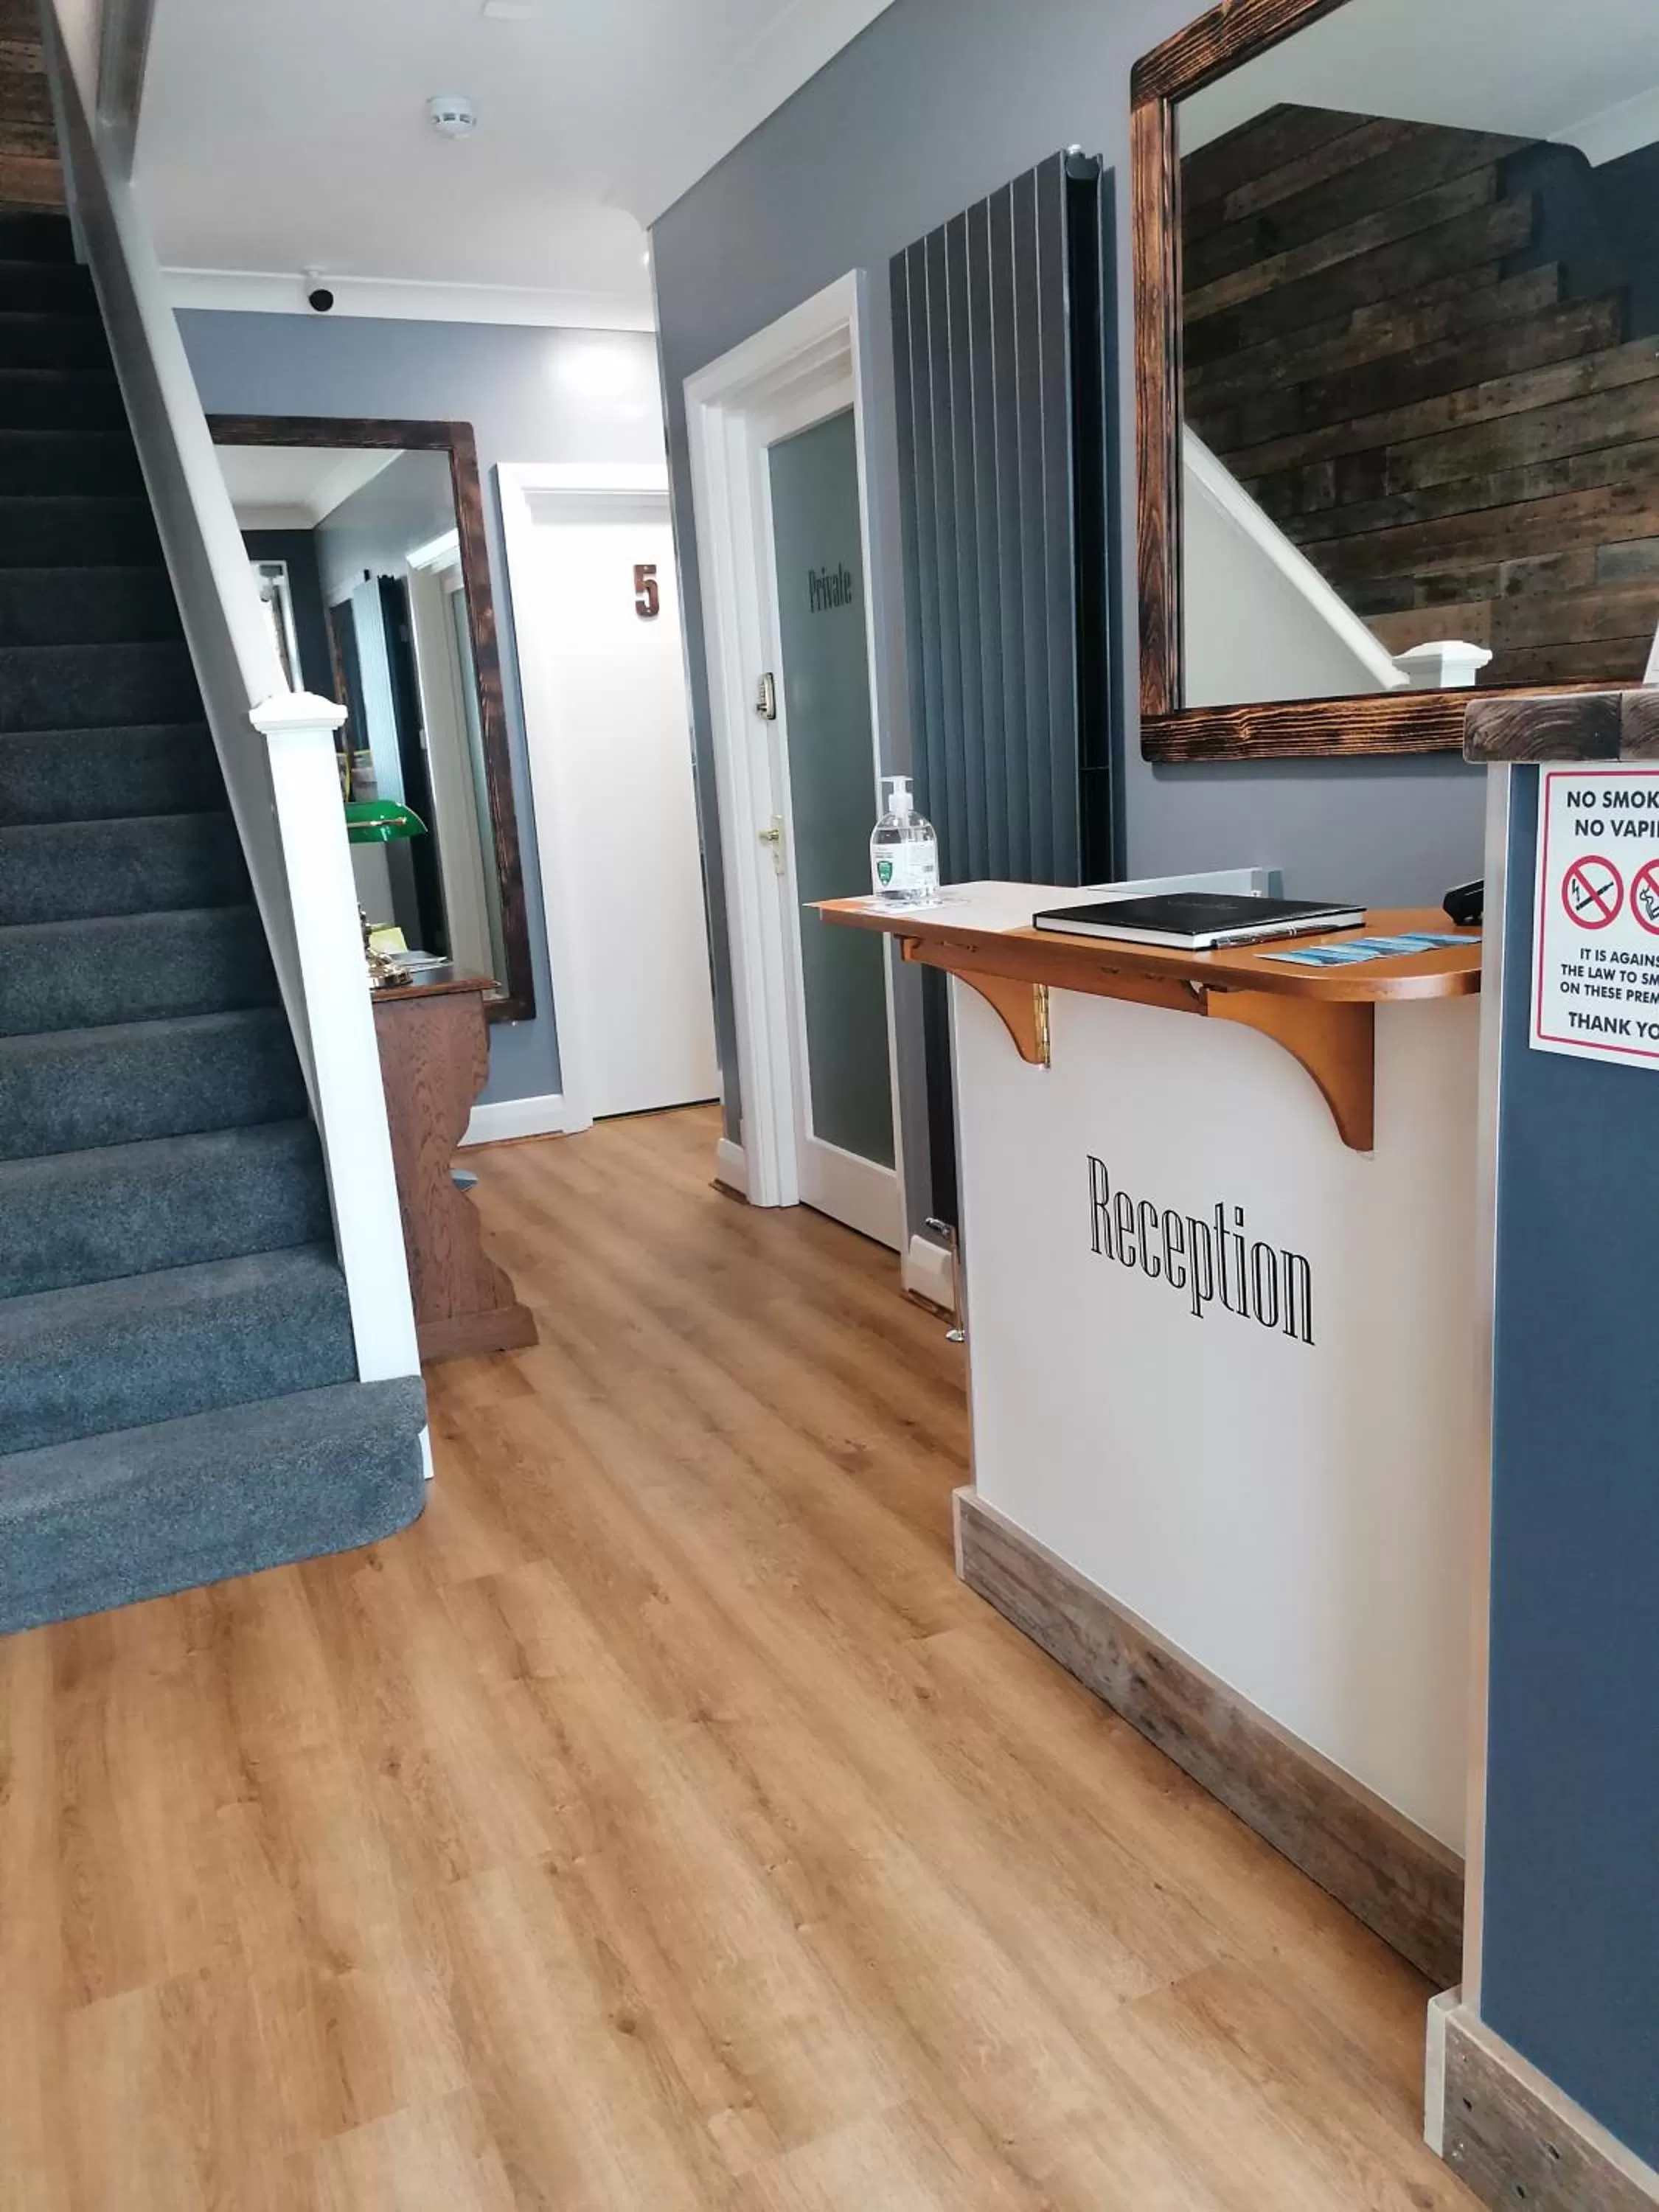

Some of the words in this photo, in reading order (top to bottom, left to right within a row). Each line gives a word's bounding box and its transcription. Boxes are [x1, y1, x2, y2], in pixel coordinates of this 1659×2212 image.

[633, 564, 660, 618] 5
[808, 563, 852, 613] Private
[1567, 790, 1596, 808] NO
[1602, 790, 1659, 808] SMOK
[1575, 819, 1604, 837] NO
[1610, 819, 1659, 838] VAPI
[1580, 947, 1592, 960] IT
[1595, 950, 1607, 961] IS
[1561, 964, 1585, 977] THE
[1587, 967, 1615, 981] LAW
[1619, 970, 1637, 983] TO
[1559, 981, 1580, 994] ON
[1584, 984, 1622, 999] THESE
[1568, 1012, 1632, 1036] THANK
[1636, 1021, 1659, 1040] YO
[1087, 1155, 1315, 1346] Reception
